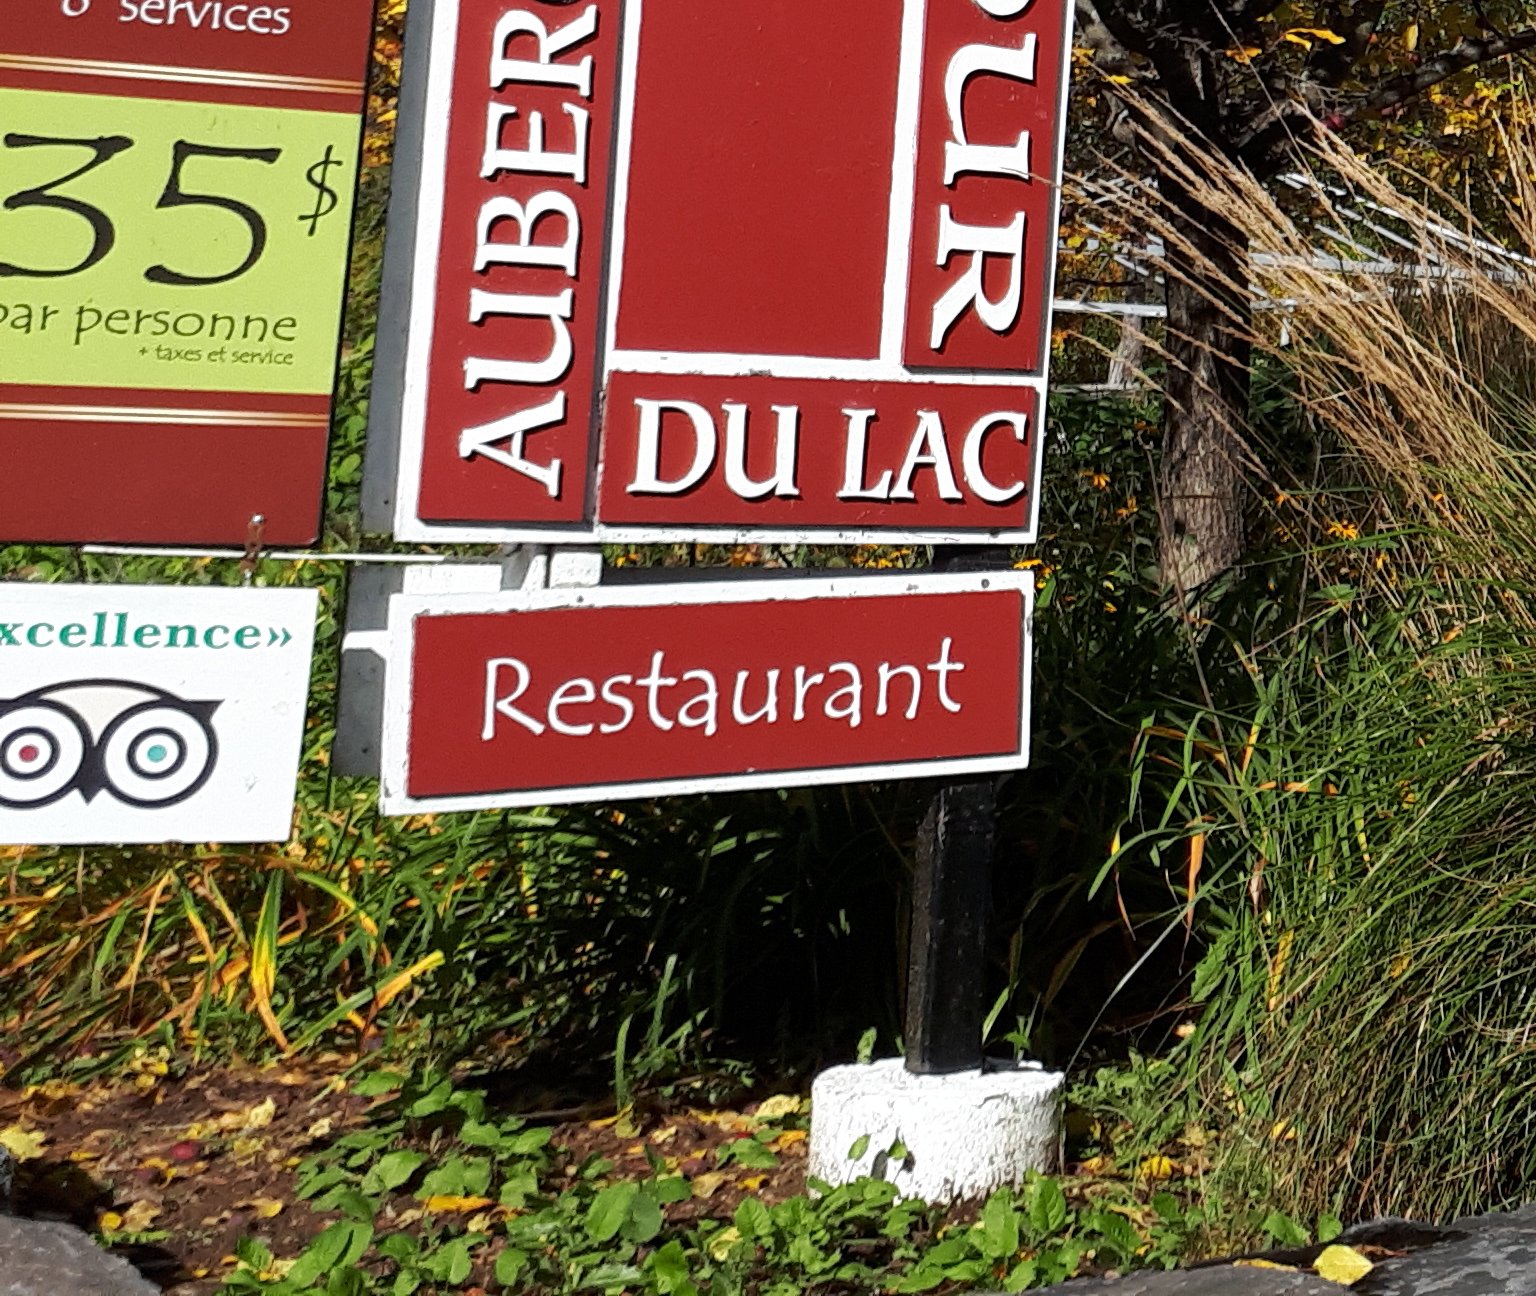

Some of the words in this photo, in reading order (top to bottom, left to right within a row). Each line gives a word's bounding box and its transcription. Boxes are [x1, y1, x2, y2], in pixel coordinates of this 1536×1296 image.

[0, 303, 59, 335] ar
[73, 303, 297, 346] personne
[155, 344, 202, 363] taxes
[207, 346, 228, 364] et
[231, 346, 294, 366] service
[627, 397, 801, 500] DU
[836, 407, 1028, 504] LAC
[481, 636, 966, 742] Restaurant
